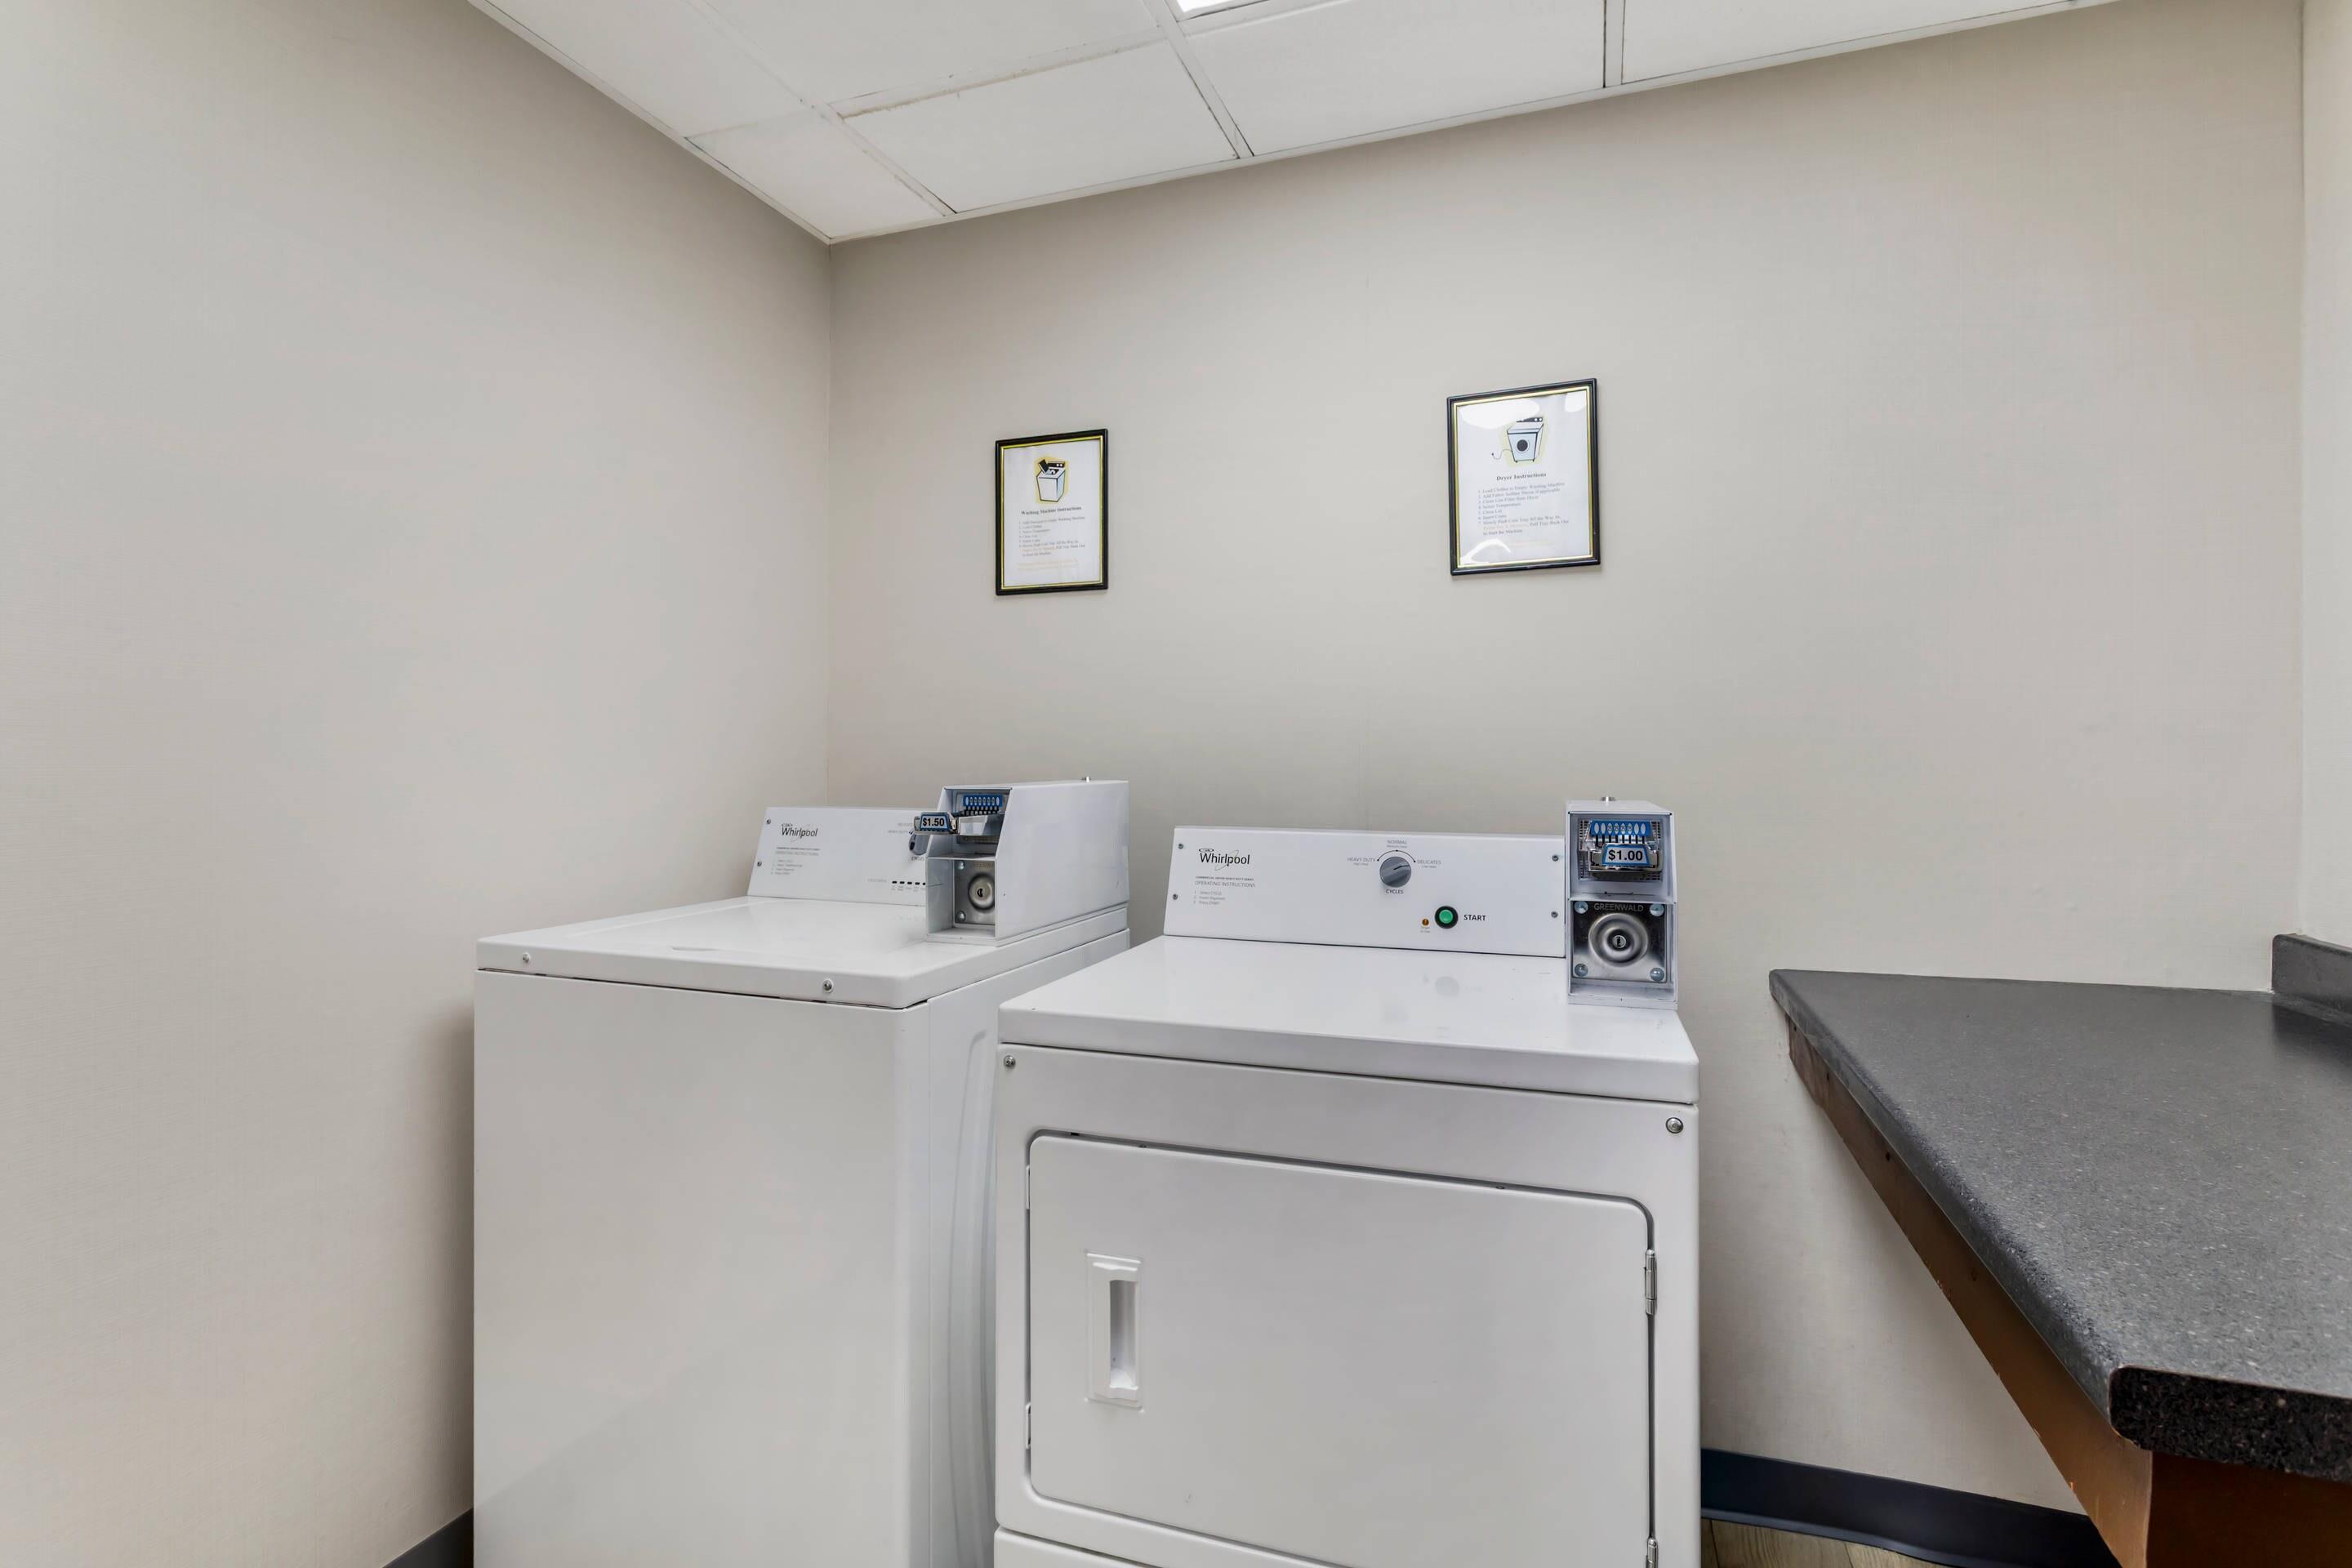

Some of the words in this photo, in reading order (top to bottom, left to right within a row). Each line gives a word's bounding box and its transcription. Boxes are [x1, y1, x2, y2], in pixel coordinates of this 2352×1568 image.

[922, 817, 945, 827] $1.50
[782, 827, 818, 839] Whirlpool
[1200, 853, 1250, 866] Whirlpool
[1608, 849, 1643, 861] $1.00
[1593, 902, 1644, 912] GREENWALD
